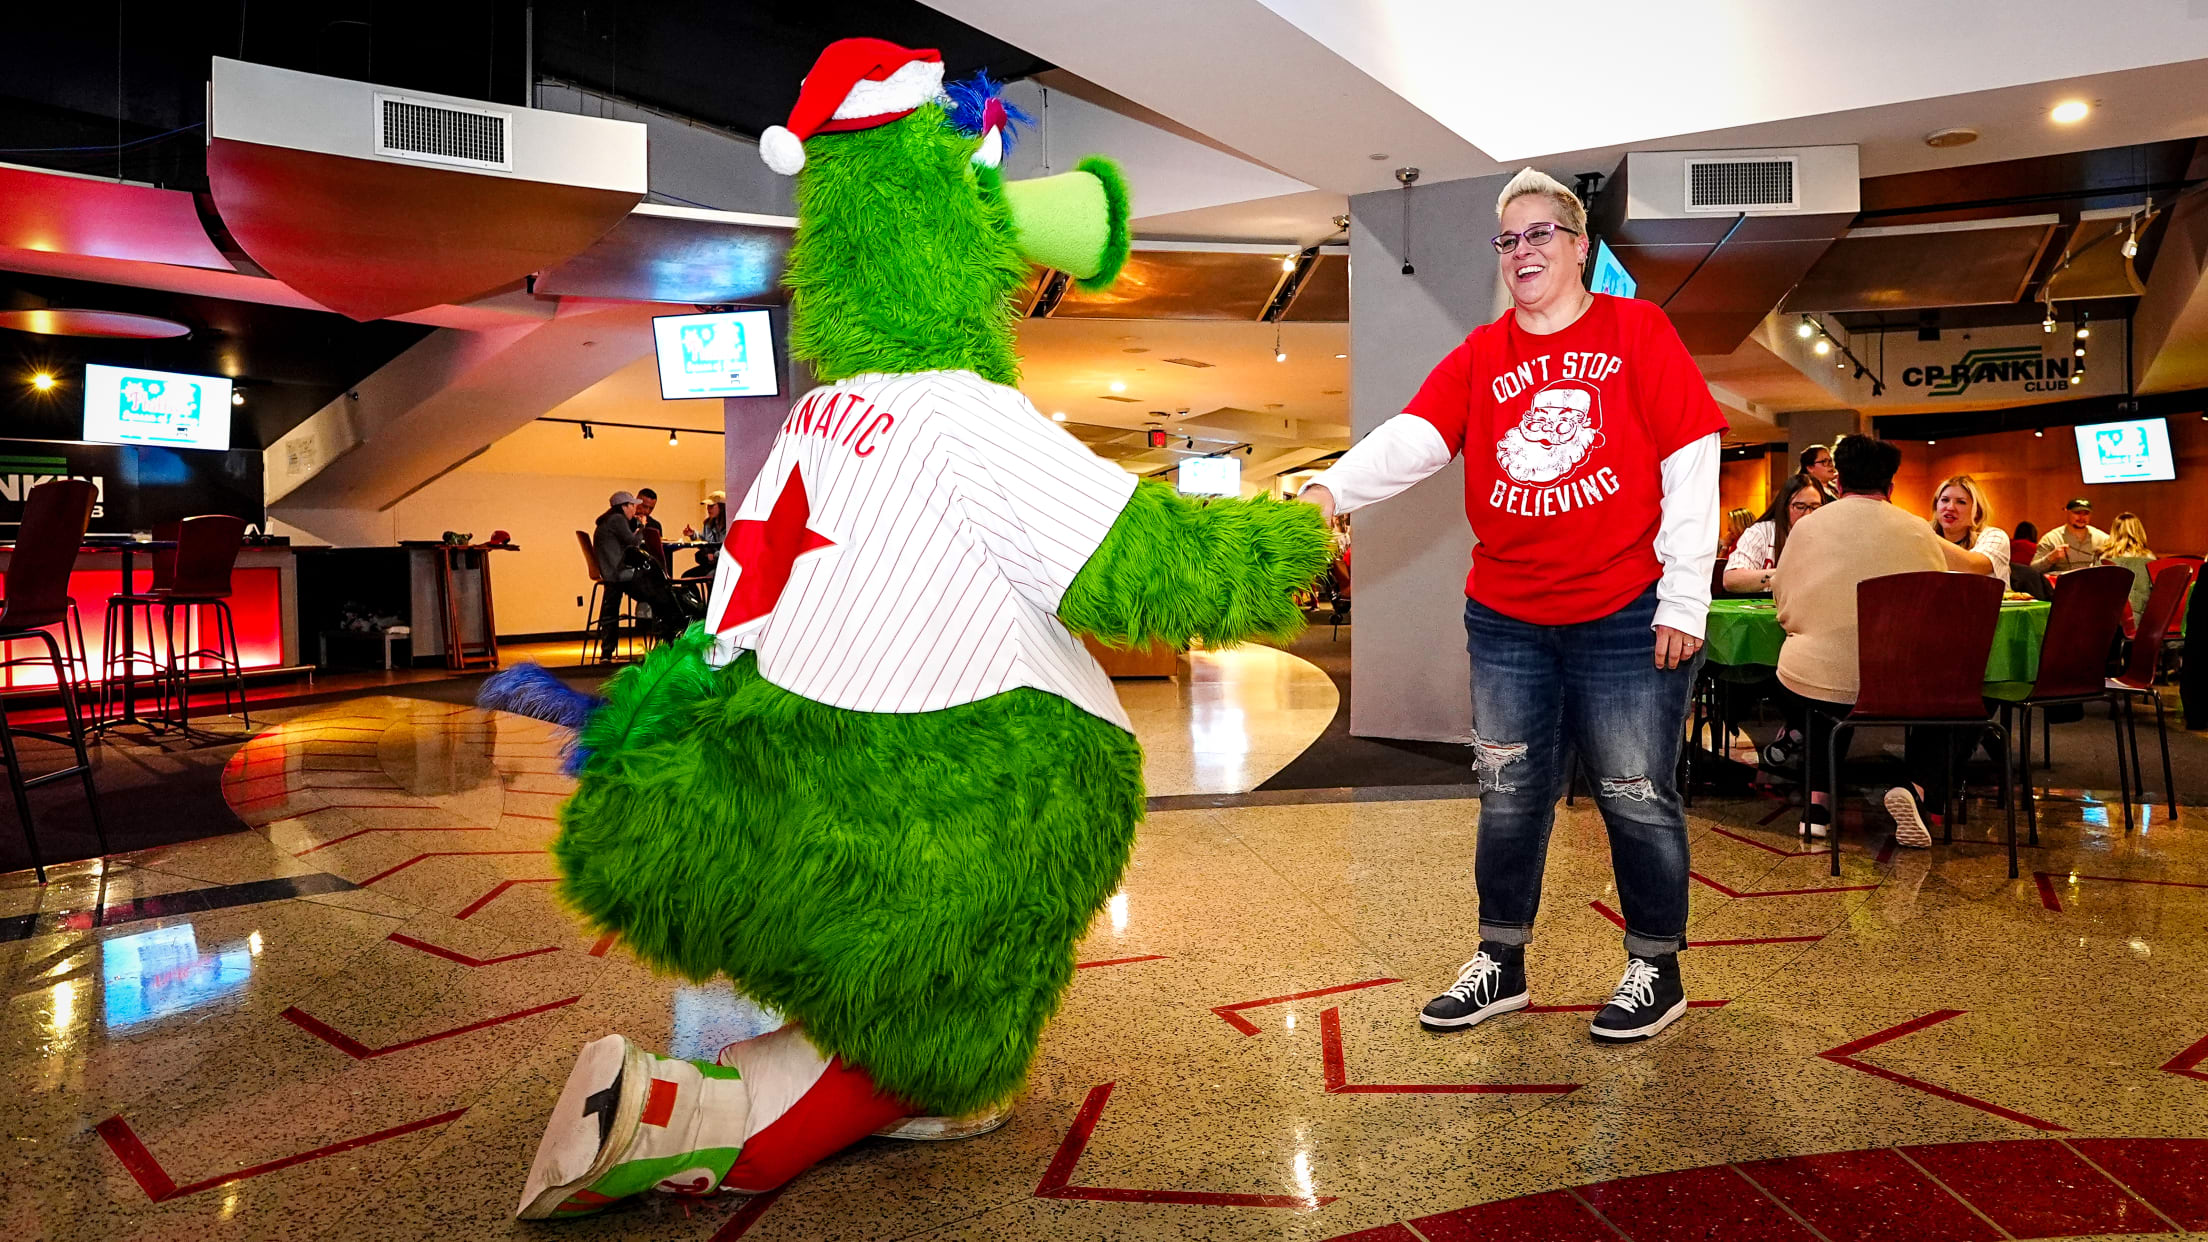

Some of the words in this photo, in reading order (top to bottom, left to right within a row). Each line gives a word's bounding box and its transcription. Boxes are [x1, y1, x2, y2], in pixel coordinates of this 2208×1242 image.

[1492, 354, 1551, 404] DON'T
[1562, 351, 1623, 381] STOP
[1902, 365, 1945, 387] CP
[1951, 357, 2069, 385] RANKIN
[2024, 379, 2069, 392] CLUB
[1489, 466, 1621, 517] BELIEVING
